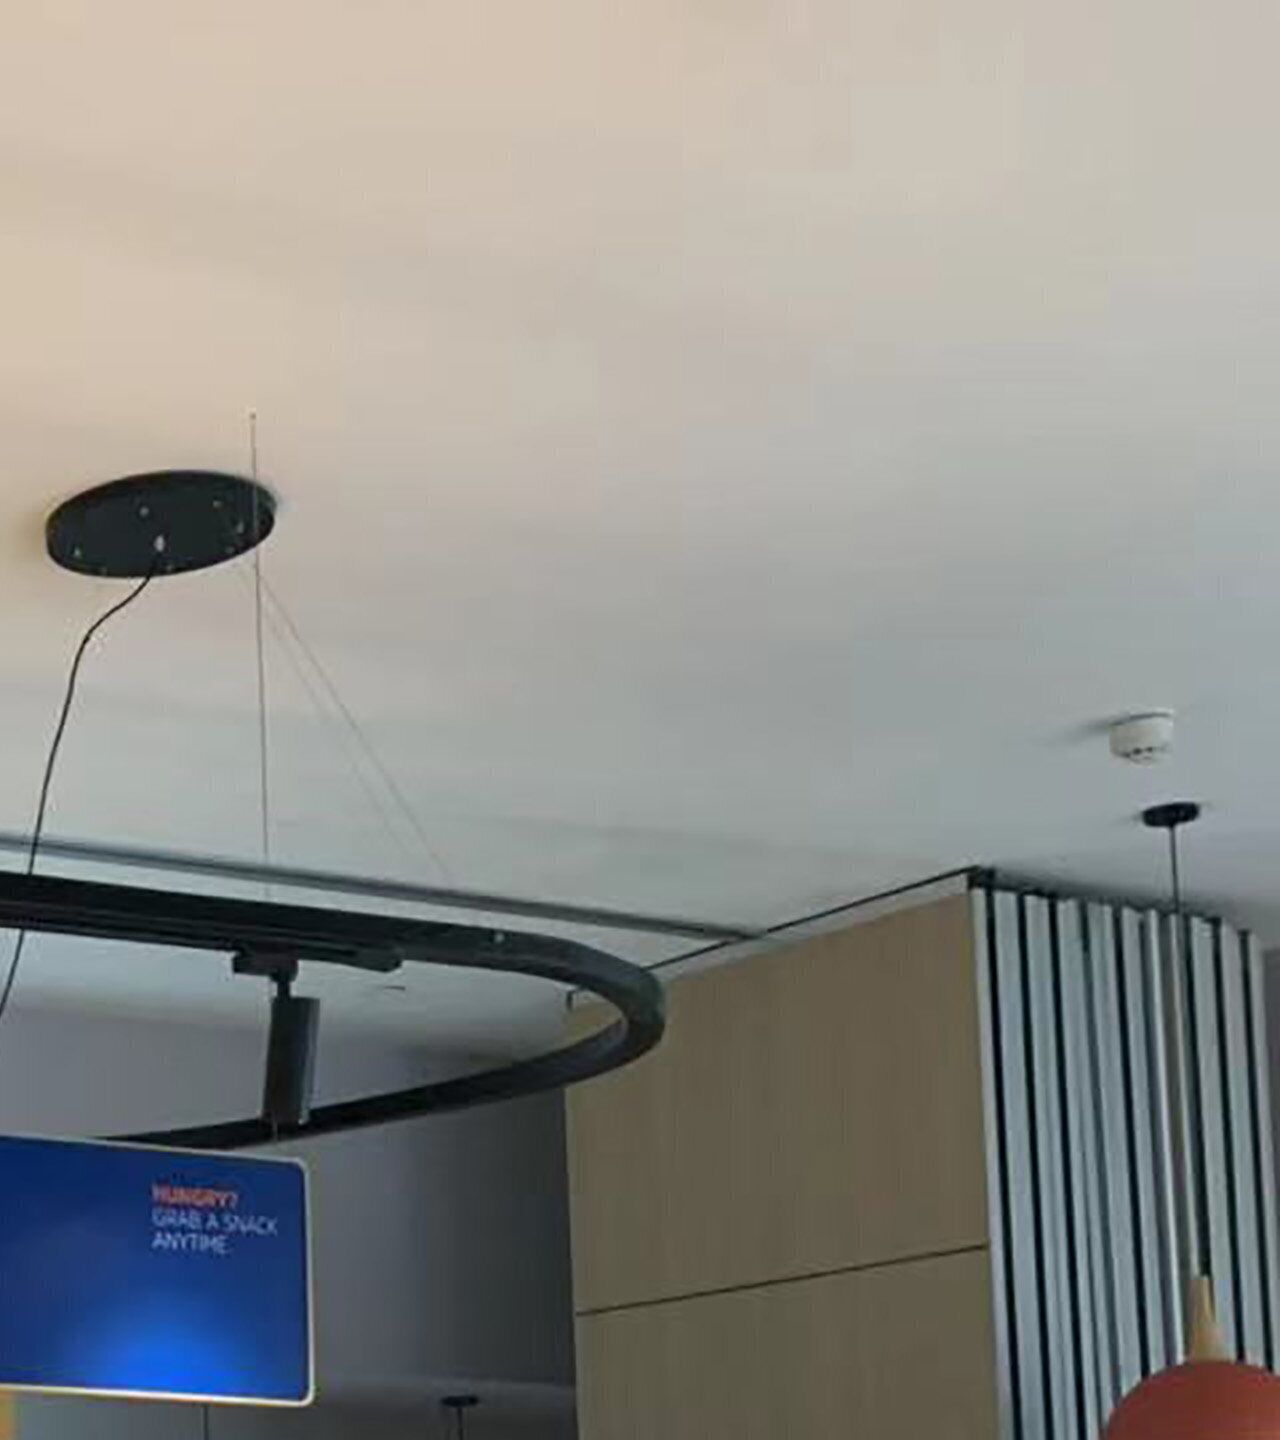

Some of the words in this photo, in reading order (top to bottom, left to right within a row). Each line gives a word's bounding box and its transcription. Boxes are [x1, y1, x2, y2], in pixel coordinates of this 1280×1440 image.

[151, 1184, 239, 1209] HUNGRY?
[151, 1207, 203, 1230] GRAB
[206, 1213, 219, 1230] A
[223, 1213, 278, 1237] SNACK
[151, 1231, 227, 1255] ANYTIME
